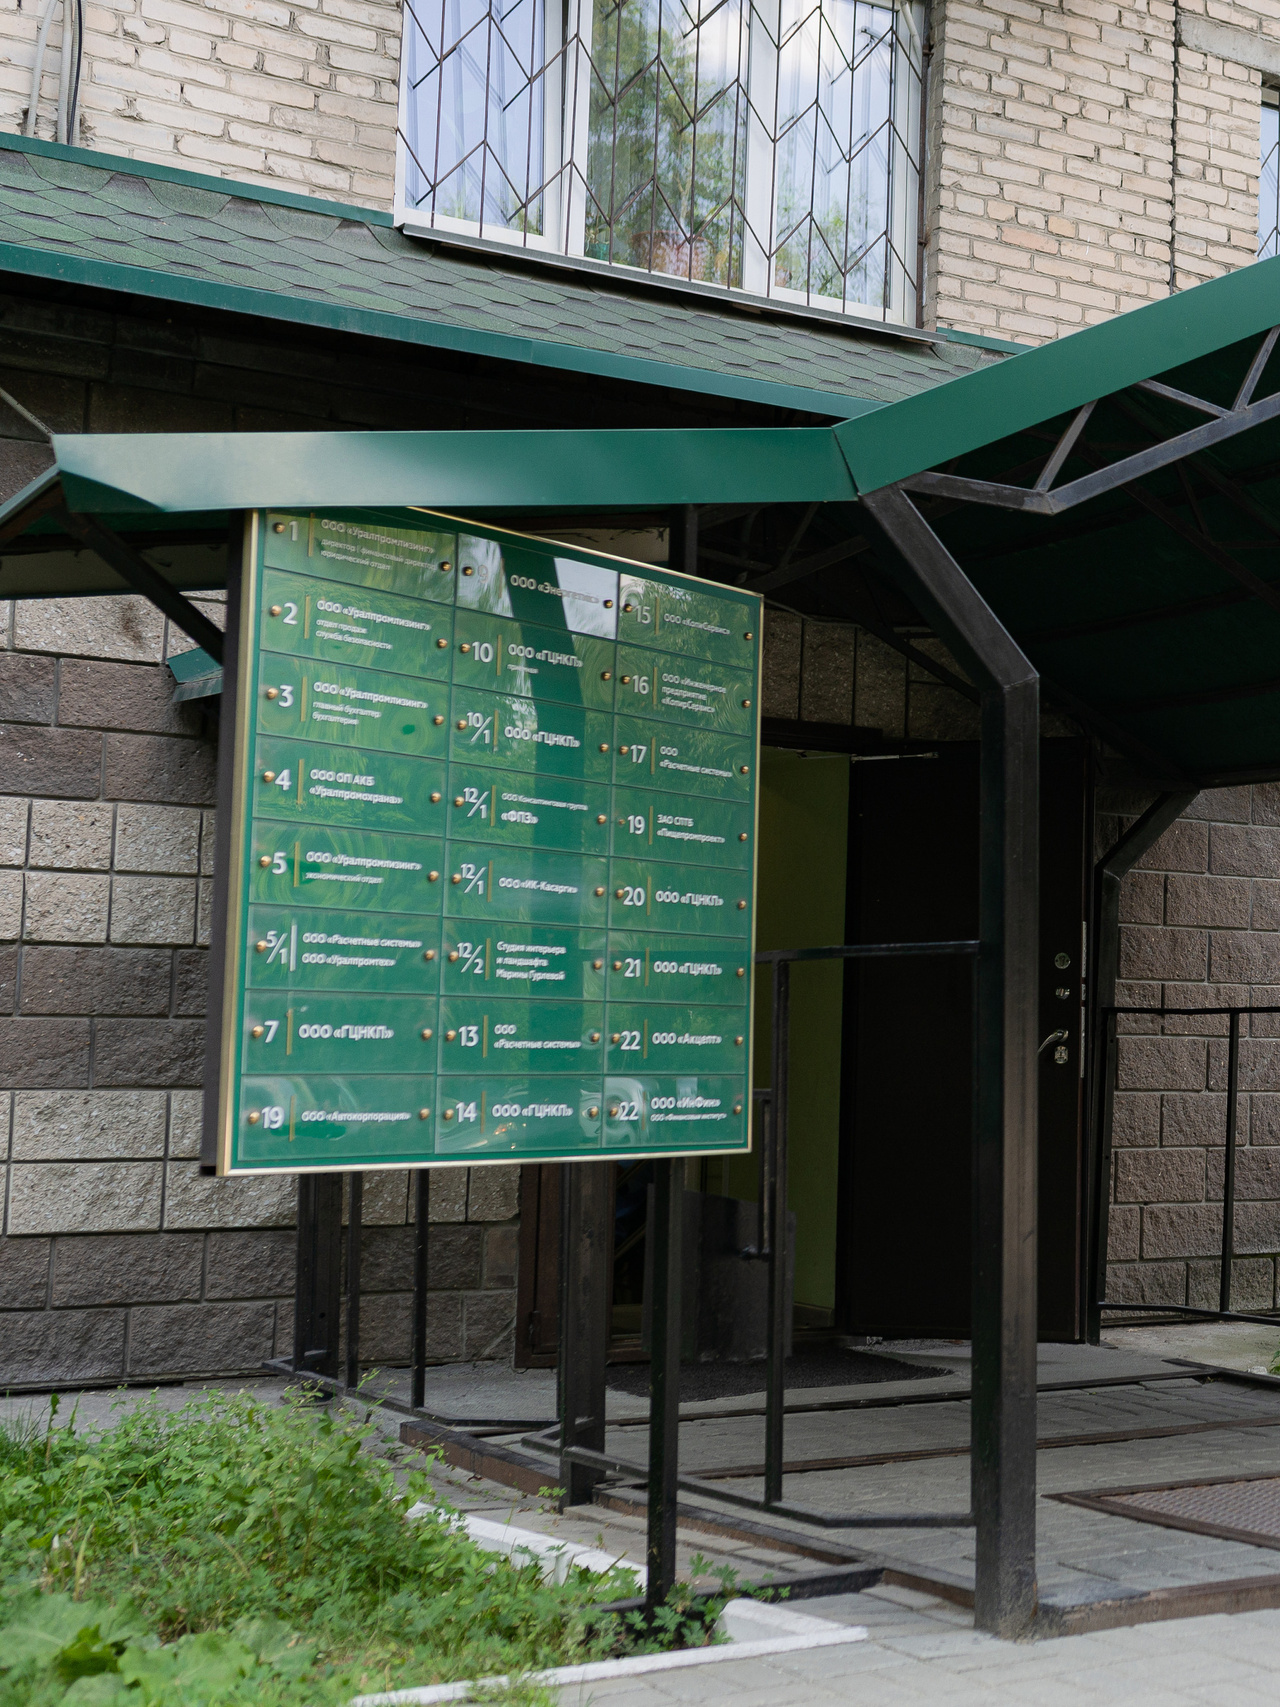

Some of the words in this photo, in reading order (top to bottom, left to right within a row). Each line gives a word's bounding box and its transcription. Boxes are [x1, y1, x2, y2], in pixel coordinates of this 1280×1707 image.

[288, 521, 298, 541] 1
[321, 519, 346, 533] ООО
[346, 525, 434, 554] «Уралпромлизинг»
[510, 574, 537, 590] ООО
[283, 602, 298, 625] 2
[316, 600, 343, 614] ООО
[342, 605, 432, 631] «Уралпромлизинг»
[635, 605, 651, 624] 15
[663, 613, 682, 624] ООО
[472, 641, 494, 663] 10
[508, 643, 535, 659] ООО
[535, 649, 583, 668] «ГЦНКП»
[632, 674, 650, 694] 16
[662, 673, 680, 684] ООО
[278, 684, 294, 708] 3
[313, 681, 339, 695] ООО
[339, 687, 429, 709] «Уралпромлизинг»
[504, 726, 532, 740] ООО
[532, 731, 580, 748] «ГЦНКП»
[630, 745, 647, 763] 17
[660, 746, 678, 756] ООО
[275, 769, 292, 791] 4
[309, 769, 335, 782] ООО
[336, 771, 351, 783] ОП
[352, 773, 375, 787] АКБ
[309, 785, 403, 804] «Уралпромохрана»
[501, 793, 518, 801] ООО
[627, 814, 645, 834] 19
[271, 851, 287, 875] 5
[306, 851, 332, 863] ООО
[332, 854, 422, 871] «Уралпромлизинг»
[498, 877, 521, 888] ООО
[623, 886, 646, 906] 20
[655, 890, 680, 903] ООО
[680, 893, 724, 906] «ГЦНКП»
[302, 932, 327, 944] ООО
[302, 953, 326, 964] ООО
[624, 958, 641, 978] 21
[653, 961, 678, 974] ООО
[678, 962, 723, 976] «ГЦНКП»
[264, 1020, 280, 1043] 7
[298, 1024, 333, 1039] ООО
[333, 1024, 394, 1041] «ГЦНКП»
[458, 1025, 479, 1047] 13
[494, 1024, 517, 1035] ООО
[652, 1032, 677, 1045] ООО
[620, 1030, 641, 1051] 22
[455, 1101, 478, 1123] 14
[492, 1103, 521, 1118] ООО
[521, 1103, 573, 1119] «ГЦНКП»
[619, 1101, 639, 1121] 22
[651, 1097, 676, 1110] ООО
[261, 1106, 285, 1129] 19
[301, 1110, 326, 1122] ООО
